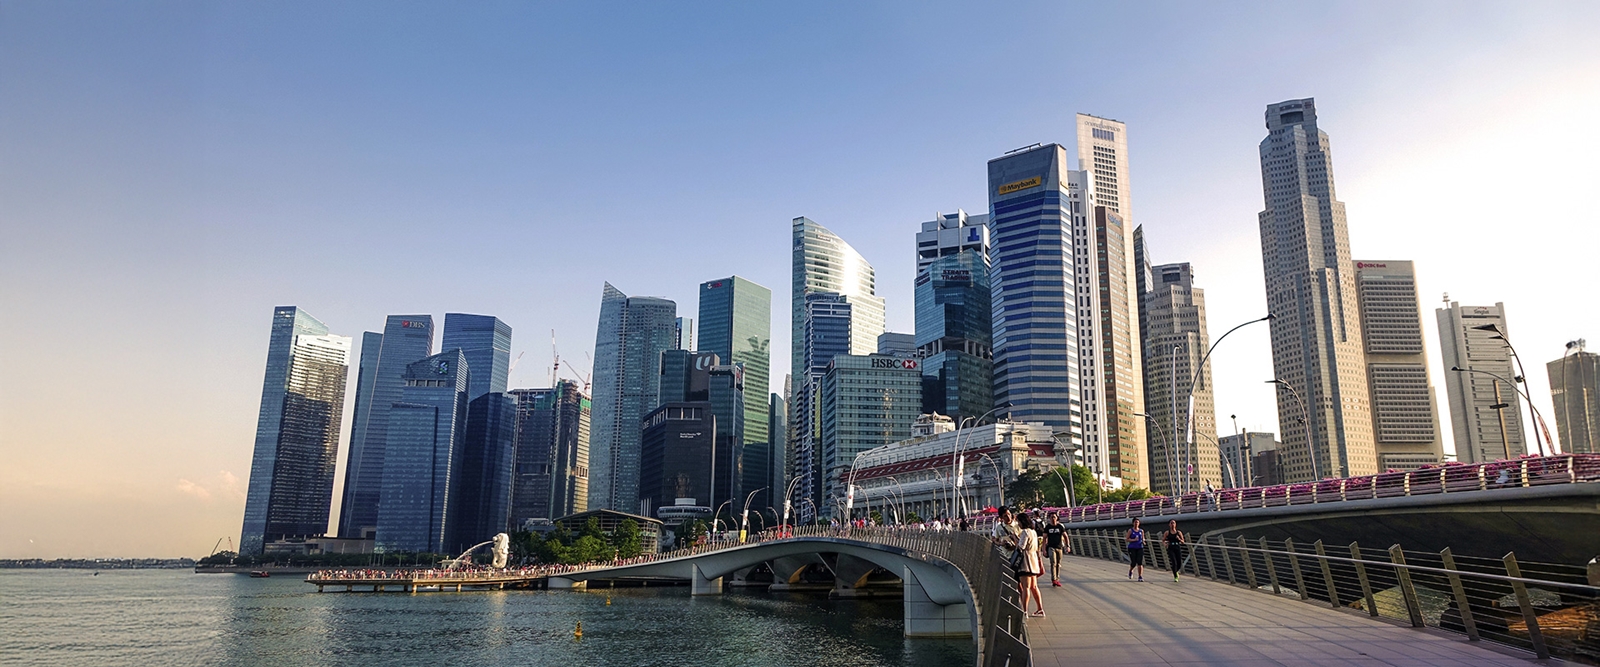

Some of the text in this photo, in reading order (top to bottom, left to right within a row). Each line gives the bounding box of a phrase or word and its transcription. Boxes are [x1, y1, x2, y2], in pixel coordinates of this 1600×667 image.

[1007, 178, 1037, 190] Maybank
[409, 321, 425, 329] DBS
[871, 358, 901, 369] HSBC
